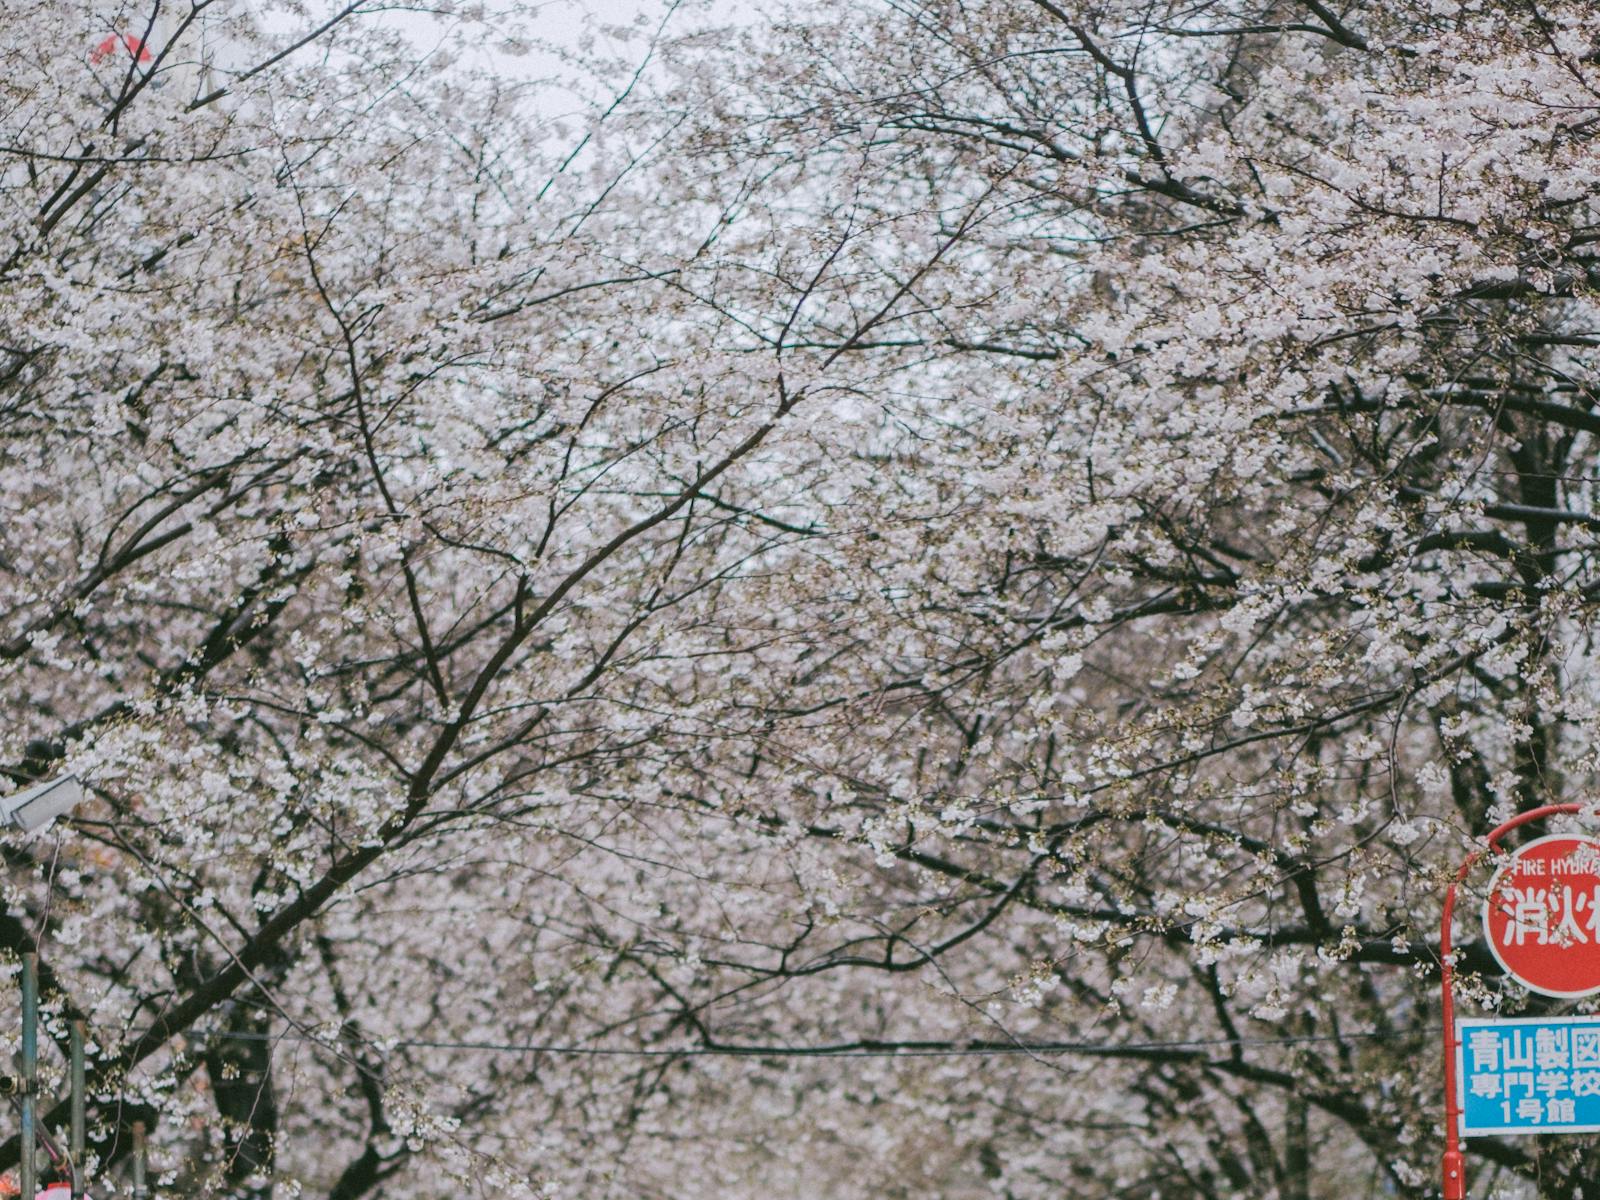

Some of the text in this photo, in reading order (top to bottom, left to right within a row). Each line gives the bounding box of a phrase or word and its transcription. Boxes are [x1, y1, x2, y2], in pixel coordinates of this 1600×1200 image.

[1513, 858, 1546, 877] FIRE
[1469, 1027, 1600, 1071] 青山製図
[1470, 1070, 1600, 1099] 専門学校
[1501, 1098, 1576, 1124] 1号館
